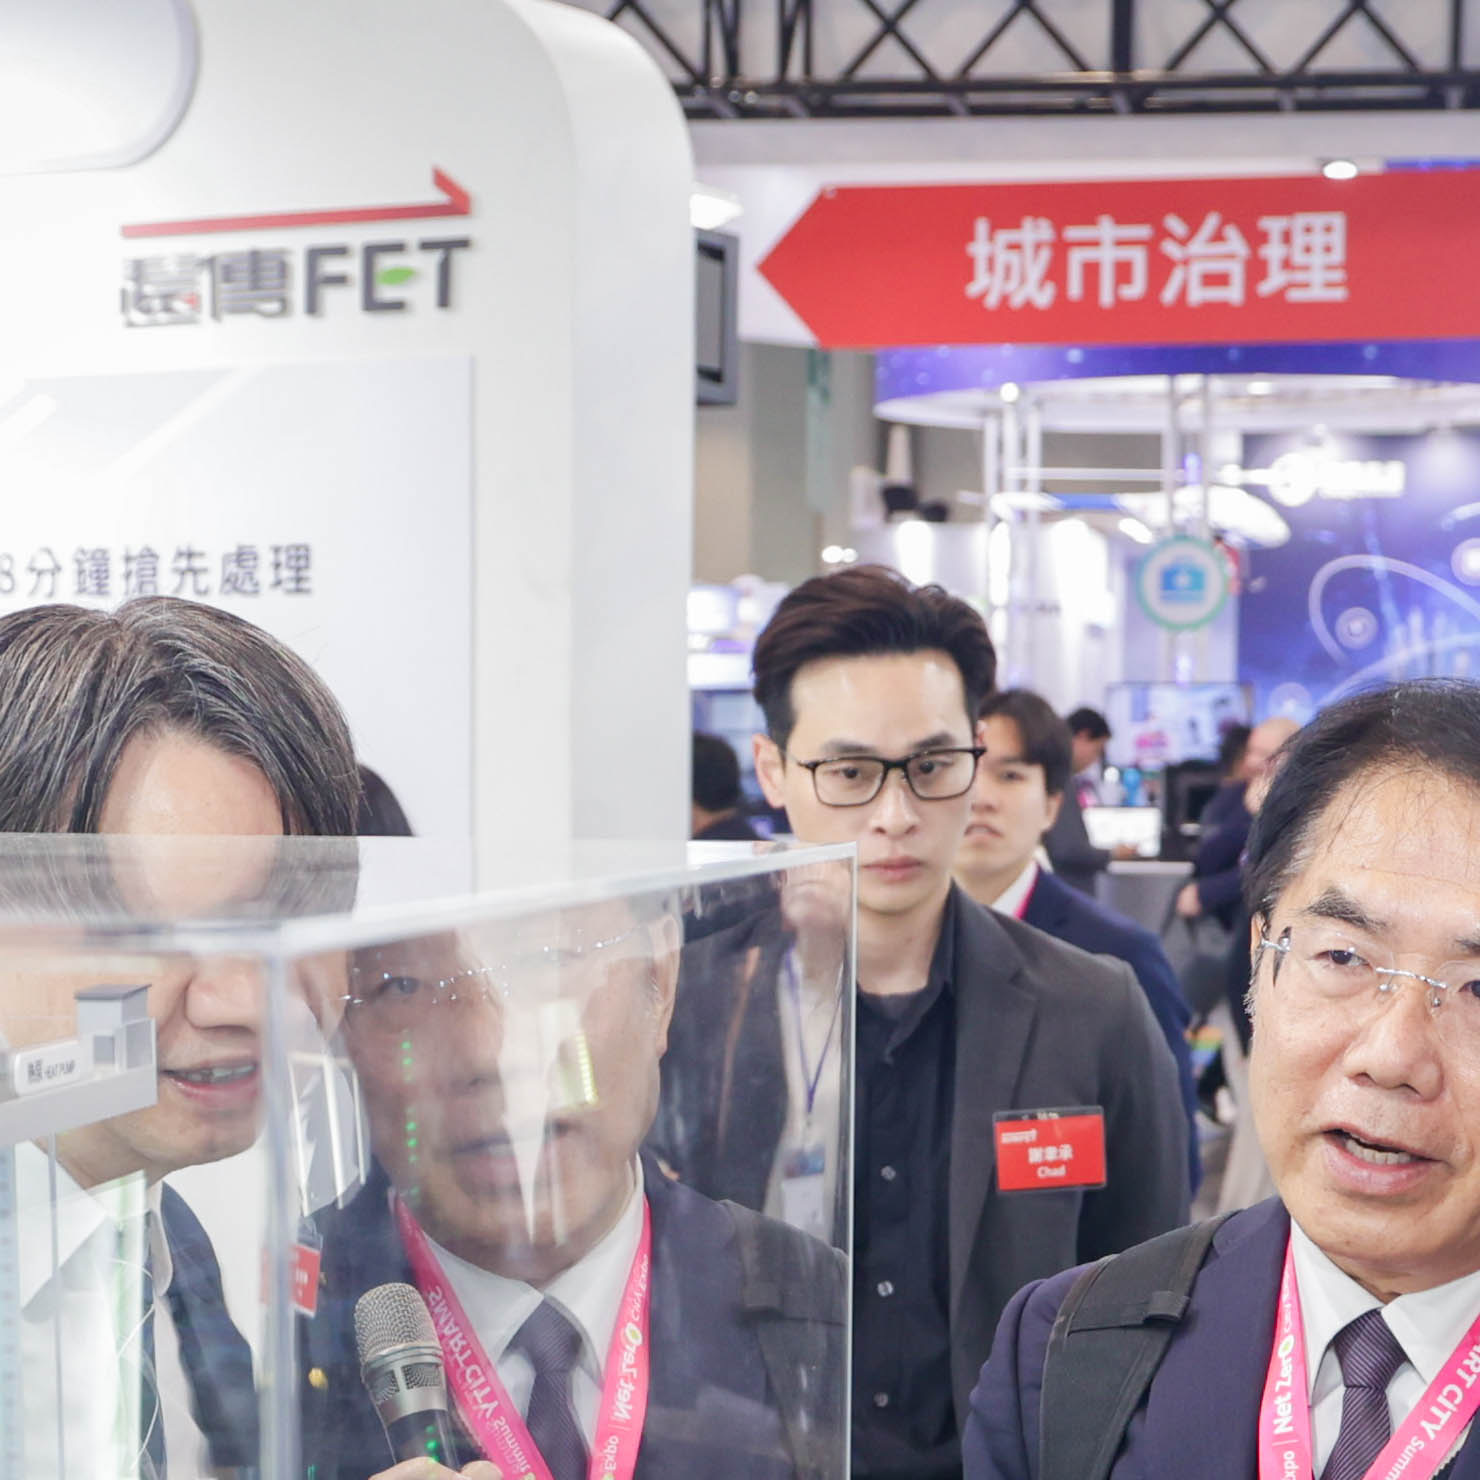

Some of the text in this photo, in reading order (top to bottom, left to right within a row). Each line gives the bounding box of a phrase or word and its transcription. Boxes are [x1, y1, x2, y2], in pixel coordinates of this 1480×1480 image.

[966, 211, 1348, 311] 城市治理
[1273, 1388, 1294, 1436] Net
[1420, 1384, 1465, 1441] CITY
